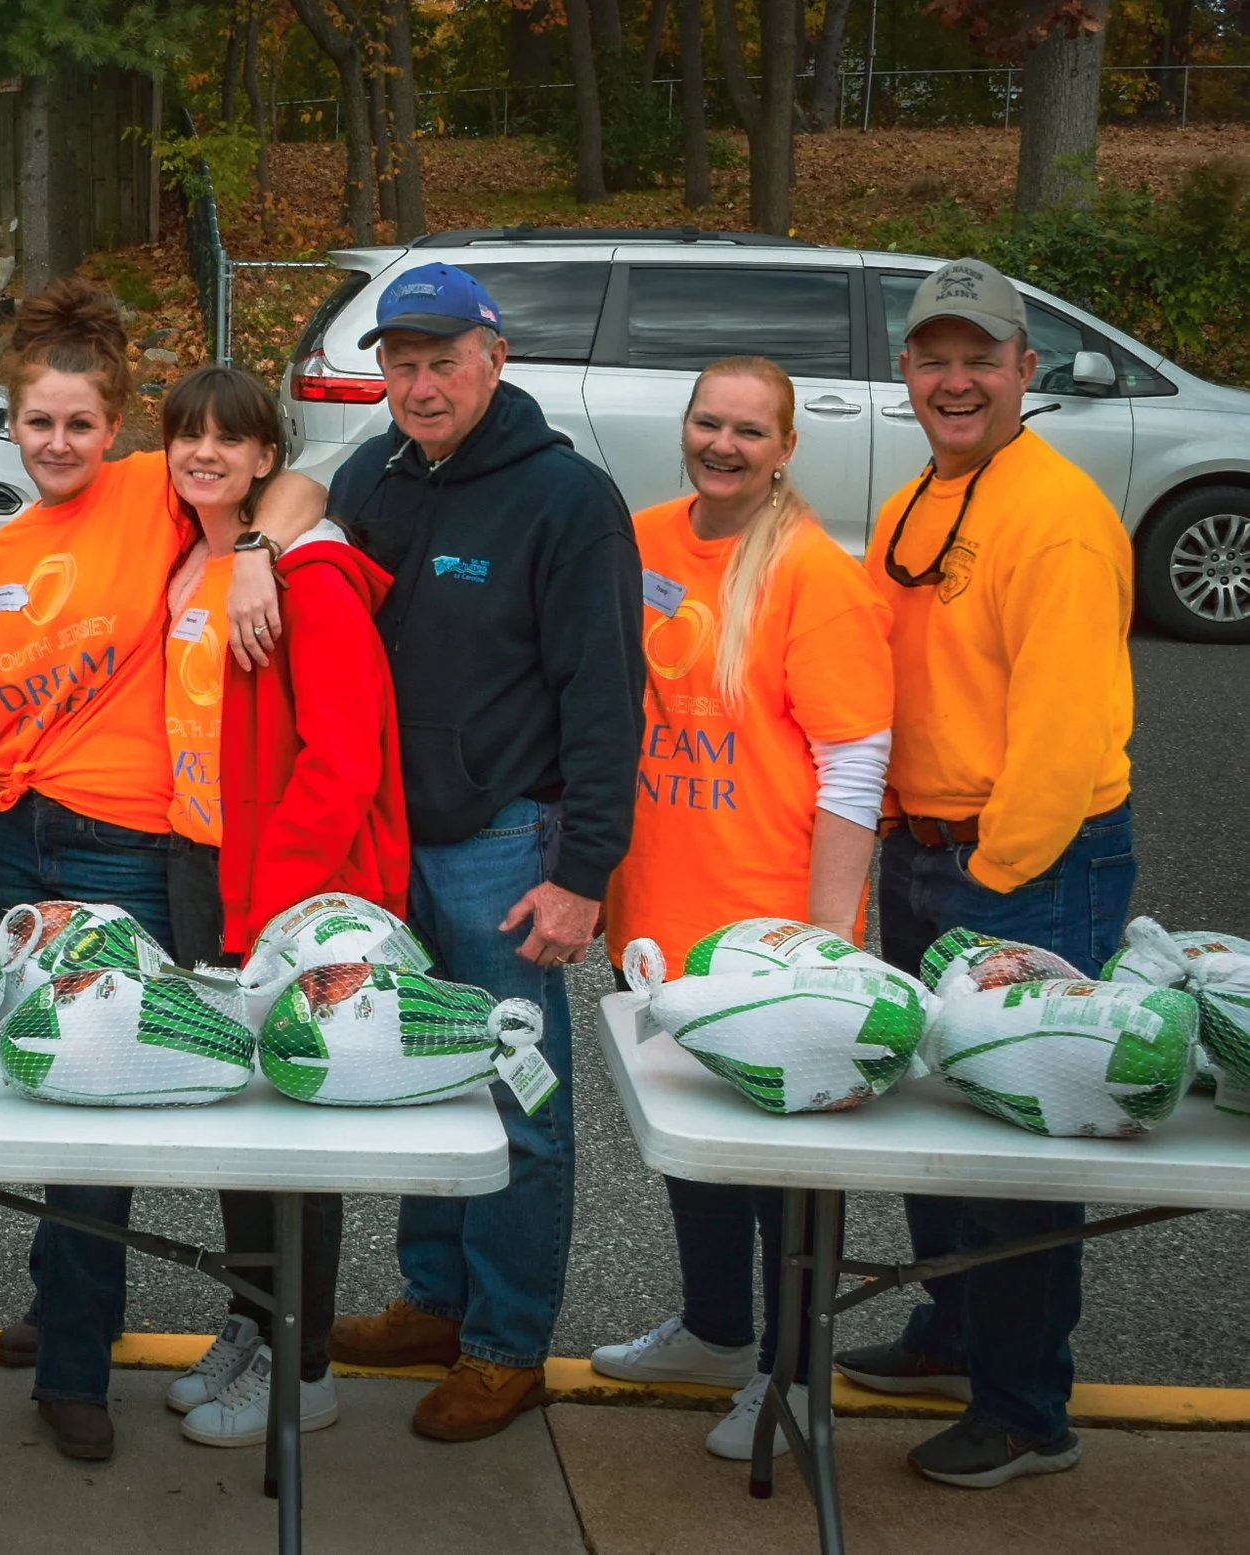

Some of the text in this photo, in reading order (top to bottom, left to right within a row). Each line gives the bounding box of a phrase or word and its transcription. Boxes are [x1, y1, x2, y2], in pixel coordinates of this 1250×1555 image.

[935, 289, 978, 302] MAINE
[666, 693, 722, 716] JERSE
[644, 724, 735, 764] EAM
[636, 770, 737, 810] NTER
